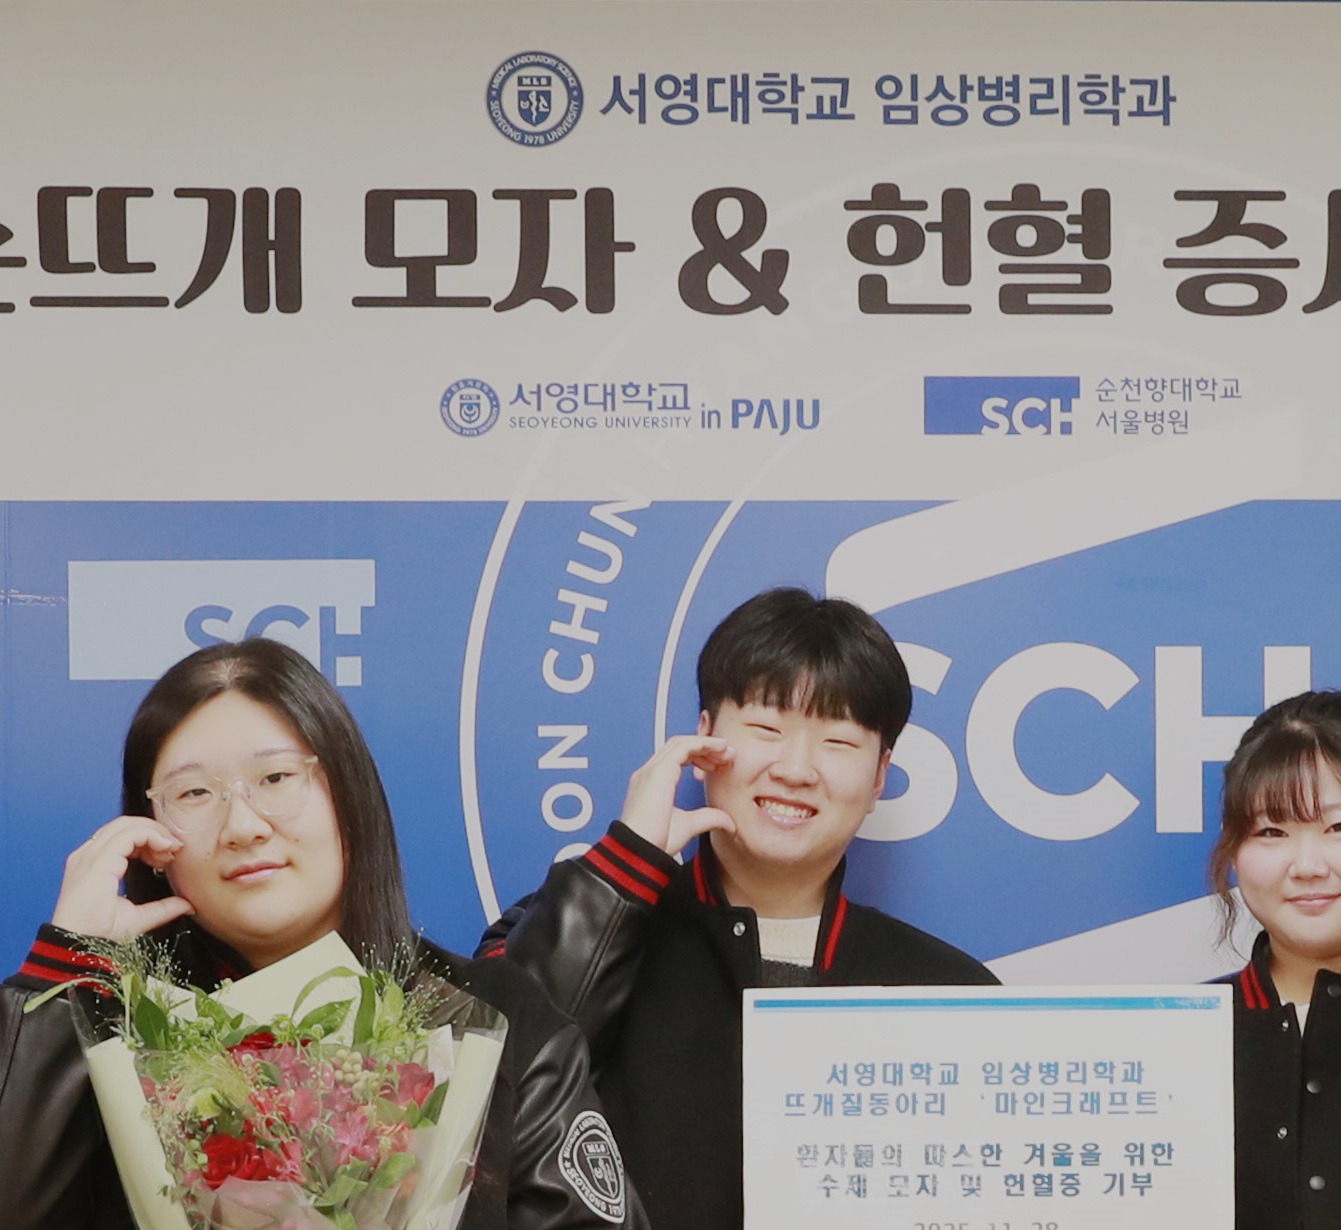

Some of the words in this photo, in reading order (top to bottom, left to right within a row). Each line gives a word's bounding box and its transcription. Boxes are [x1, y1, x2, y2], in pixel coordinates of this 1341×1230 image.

[600, 73, 856, 127] 서영대학교
[874, 73, 1177, 128] 임상병리학과
[351, 186, 636, 315] 모자
[678, 186, 790, 316] &
[843, 183, 1115, 316] 헌혈
[509, 381, 692, 414] 서영대학교
[1095, 377, 1243, 403] 순천향대학교
[509, 415, 602, 430] SEOYEONG
[604, 415, 693, 430] UNIVERSITY
[700, 403, 721, 429] in
[731, 398, 822, 436] PAJU
[1095, 409, 1189, 435] 서울병원
[826, 1062, 960, 1087] 서영대학교
[981, 1061, 1145, 1086] 임상병리학과
[784, 1092, 946, 1117] 뜨개질동아리
[924, 1143, 1003, 1168] 따스한
[1023, 1142, 1102, 1167] 겨울을
[1123, 1142, 1174, 1167] 위한
[888, 1173, 939, 1198] 모자
[1003, 1173, 1082, 1198] 헌혈증
[1102, 1172, 1154, 1197] 기부
